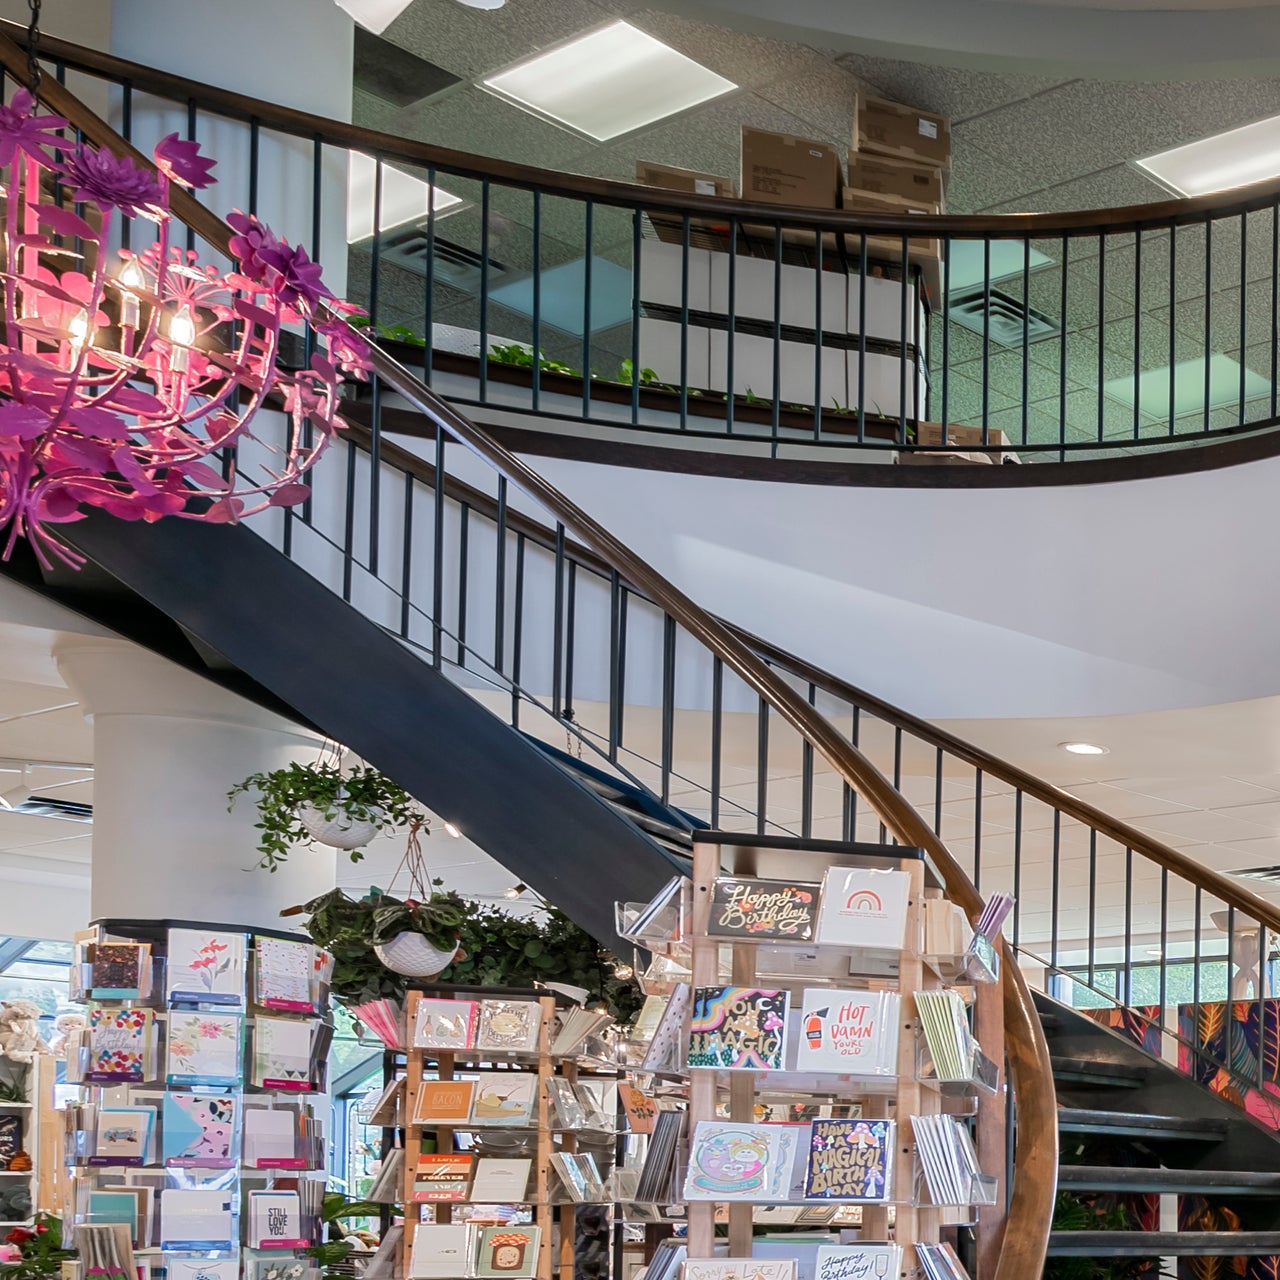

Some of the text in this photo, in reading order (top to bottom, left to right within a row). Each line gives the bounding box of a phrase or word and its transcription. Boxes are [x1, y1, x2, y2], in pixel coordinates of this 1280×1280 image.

[724, 885, 801, 909] Happy
[719, 903, 811, 930] Birthday
[839, 1001, 871, 1024] HOT
[840, 1048, 862, 1056] OLD
[432, 1092, 463, 1105] BACON
[817, 1122, 853, 1136] HAVE
[834, 1136, 848, 1147] A
[812, 1147, 884, 1174] MAGICAL
[811, 1168, 865, 1193] BIRTH
[831, 1182, 865, 1196] DAY
[268, 1208, 287, 1217] STILL
[268, 1217, 288, 1226] LOVE
[821, 1252, 866, 1270] Happy
